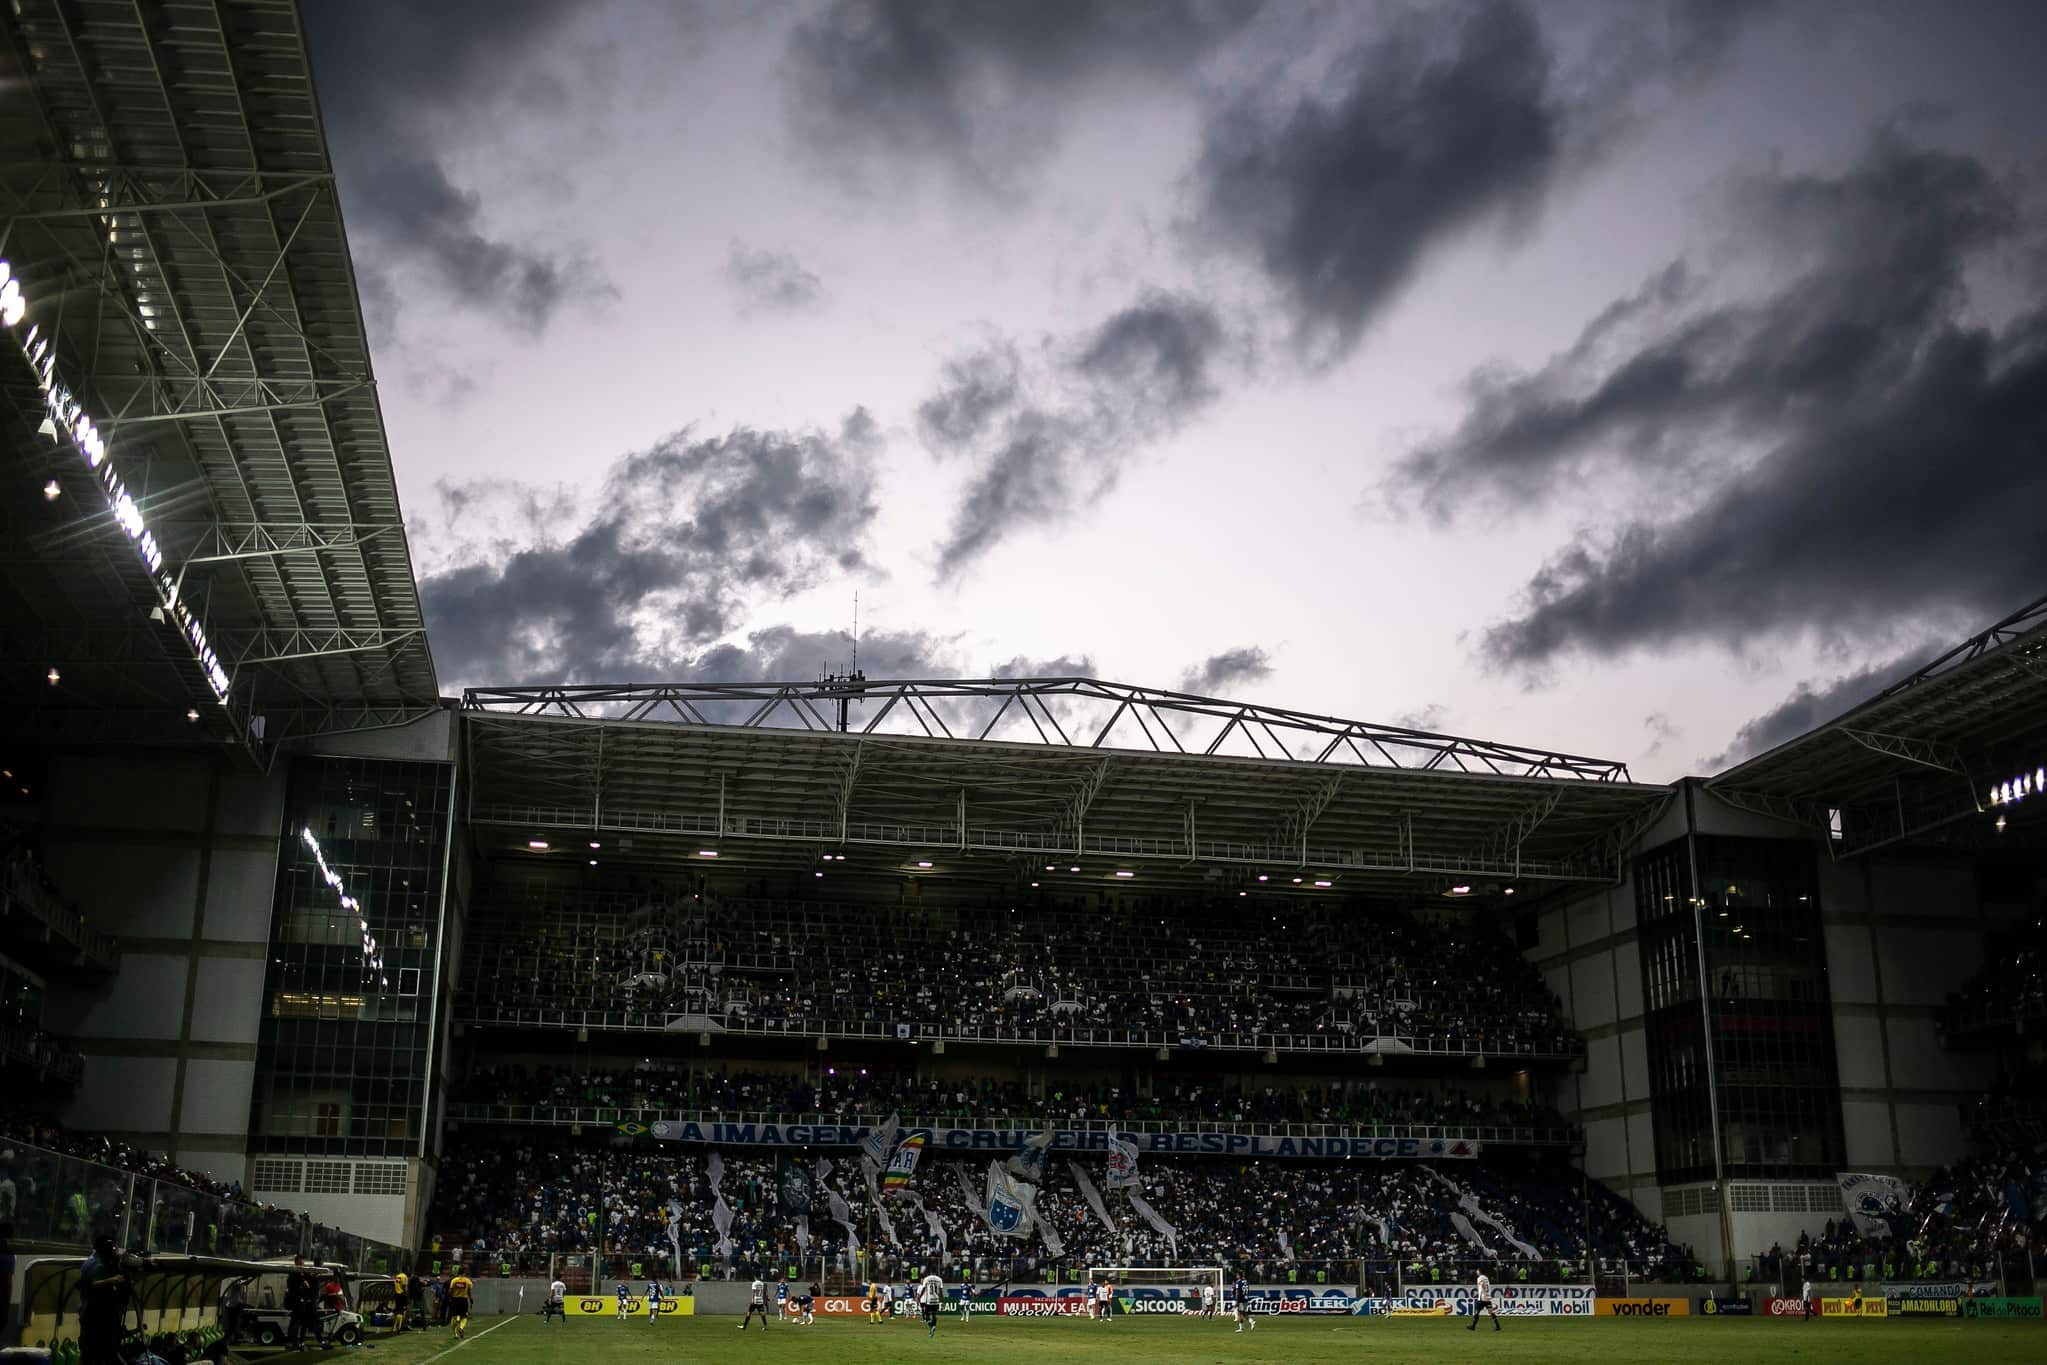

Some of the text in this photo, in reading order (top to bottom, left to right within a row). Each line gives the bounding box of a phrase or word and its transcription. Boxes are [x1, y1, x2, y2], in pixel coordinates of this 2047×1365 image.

[681, 1122, 705, 1141] A
[713, 1123, 871, 1144] IMAGEM
[1150, 1133, 1419, 1157] RESPLANDECE
[1909, 1285, 1960, 1298] COMANDO
[583, 1301, 602, 1311] BH
[825, 1300, 853, 1312] GOL
[1004, 1302, 1066, 1313] MULTIVIX
[1135, 1300, 1186, 1313] SICOOB
[1312, 1299, 1346, 1308] TEK
[1503, 1300, 1542, 1310] Mobil
[1551, 1300, 1589, 1314] Mobil
[1612, 1299, 1671, 1316] yonder
